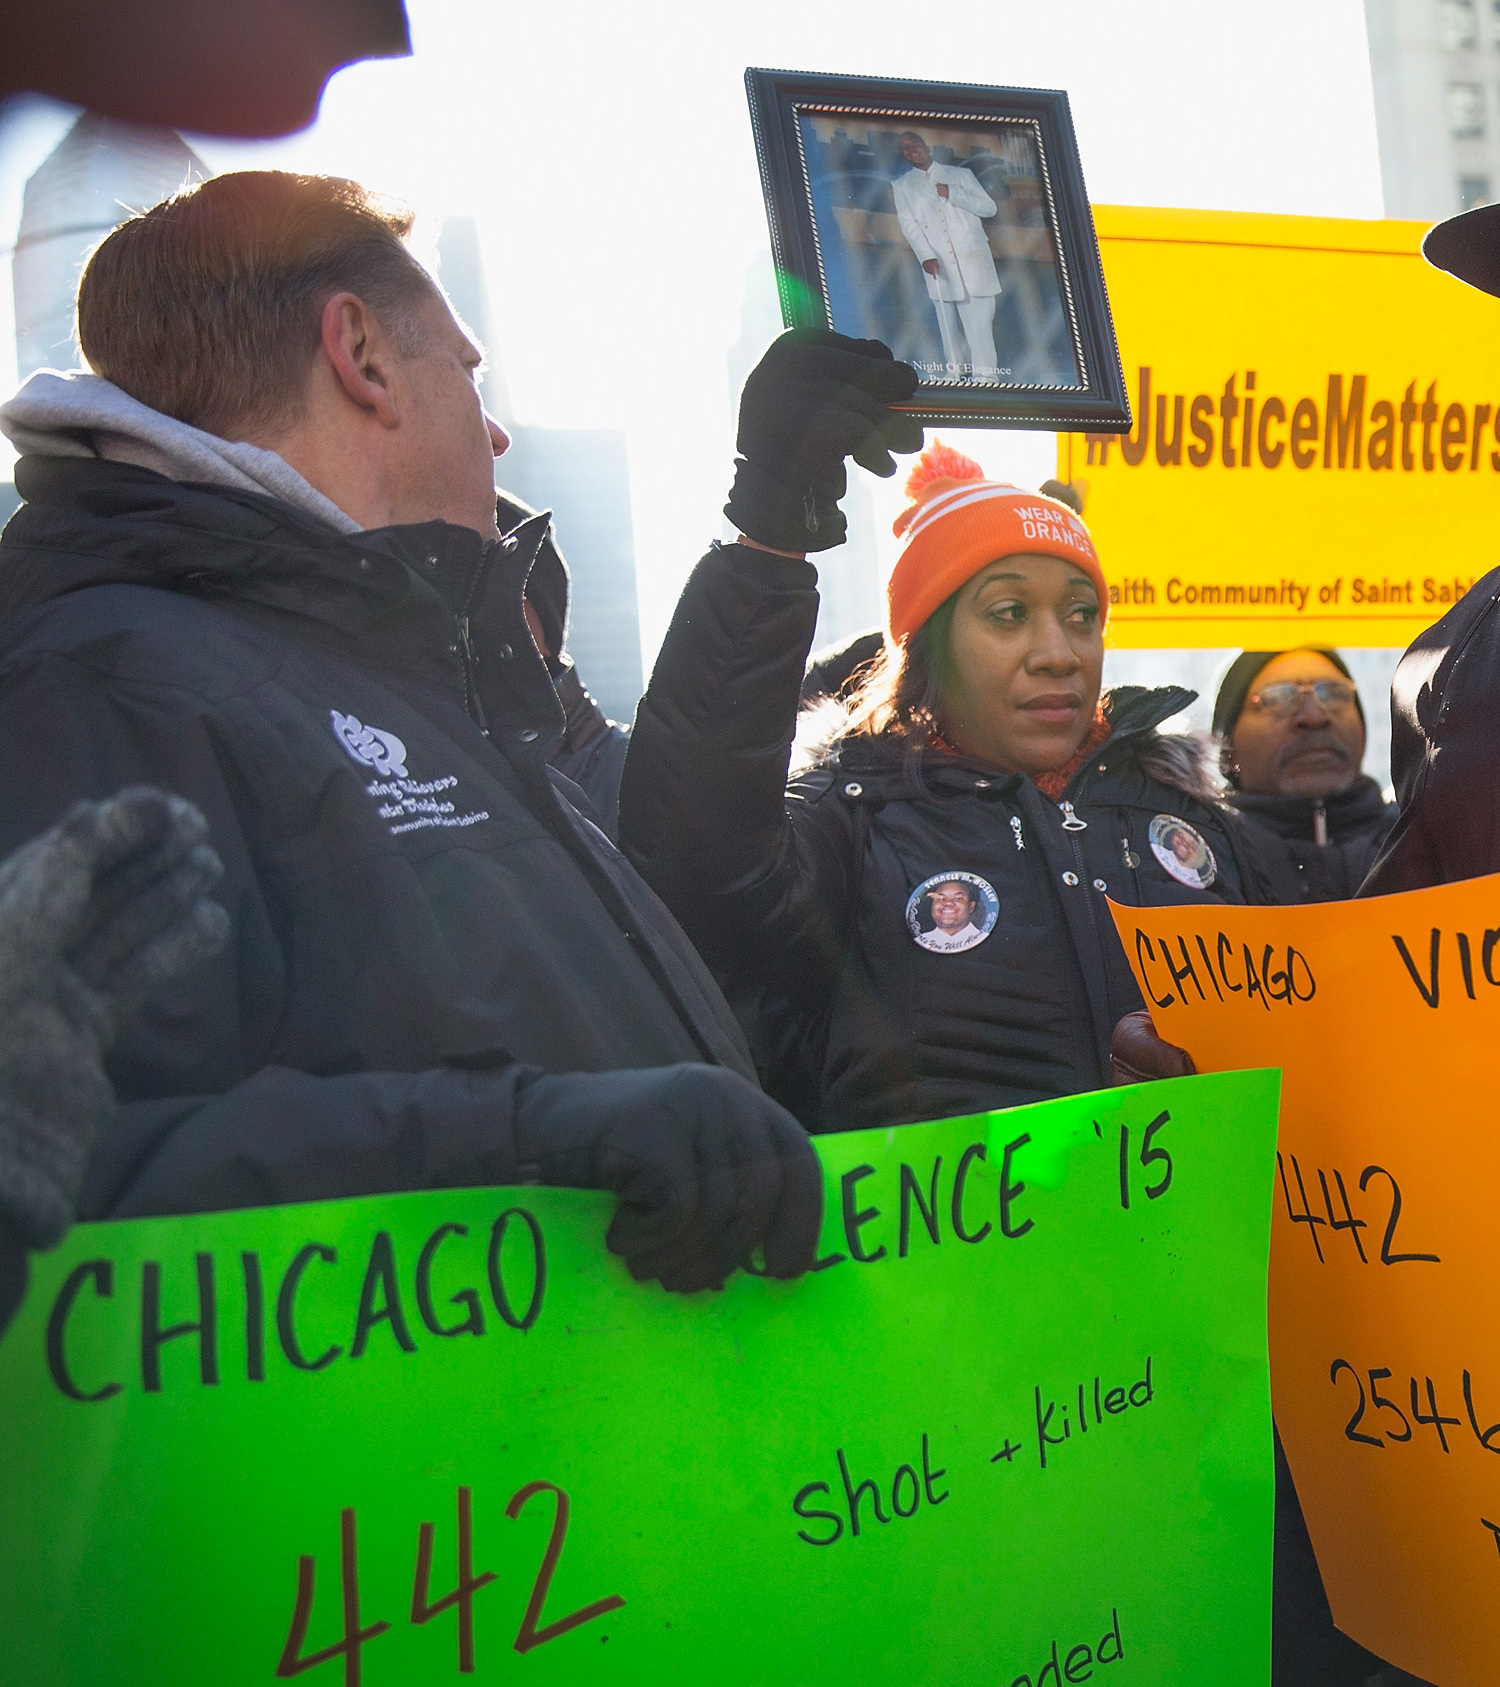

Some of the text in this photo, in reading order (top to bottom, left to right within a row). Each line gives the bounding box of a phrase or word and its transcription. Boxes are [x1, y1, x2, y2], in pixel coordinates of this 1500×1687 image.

[913, 360, 944, 373] Night
[1013, 506, 1065, 526] WEAR
[1022, 520, 1093, 558] ORANGE
[1107, 576, 1476, 611] aith Community of Saint Sab
[366, 780, 403, 800] ning
[378, 803, 405, 818] nto
[390, 816, 436, 835] ommunity
[924, 873, 960, 889] TERRELL
[973, 877, 998, 903] BOSLEY
[1135, 928, 1316, 1011] CHICAGO
[1276, 1150, 1441, 1266] 442
[46, 1206, 548, 1403] CHICAGO
[812, 1132, 1036, 1273] ENCE
[274, 1478, 627, 1687] 442
